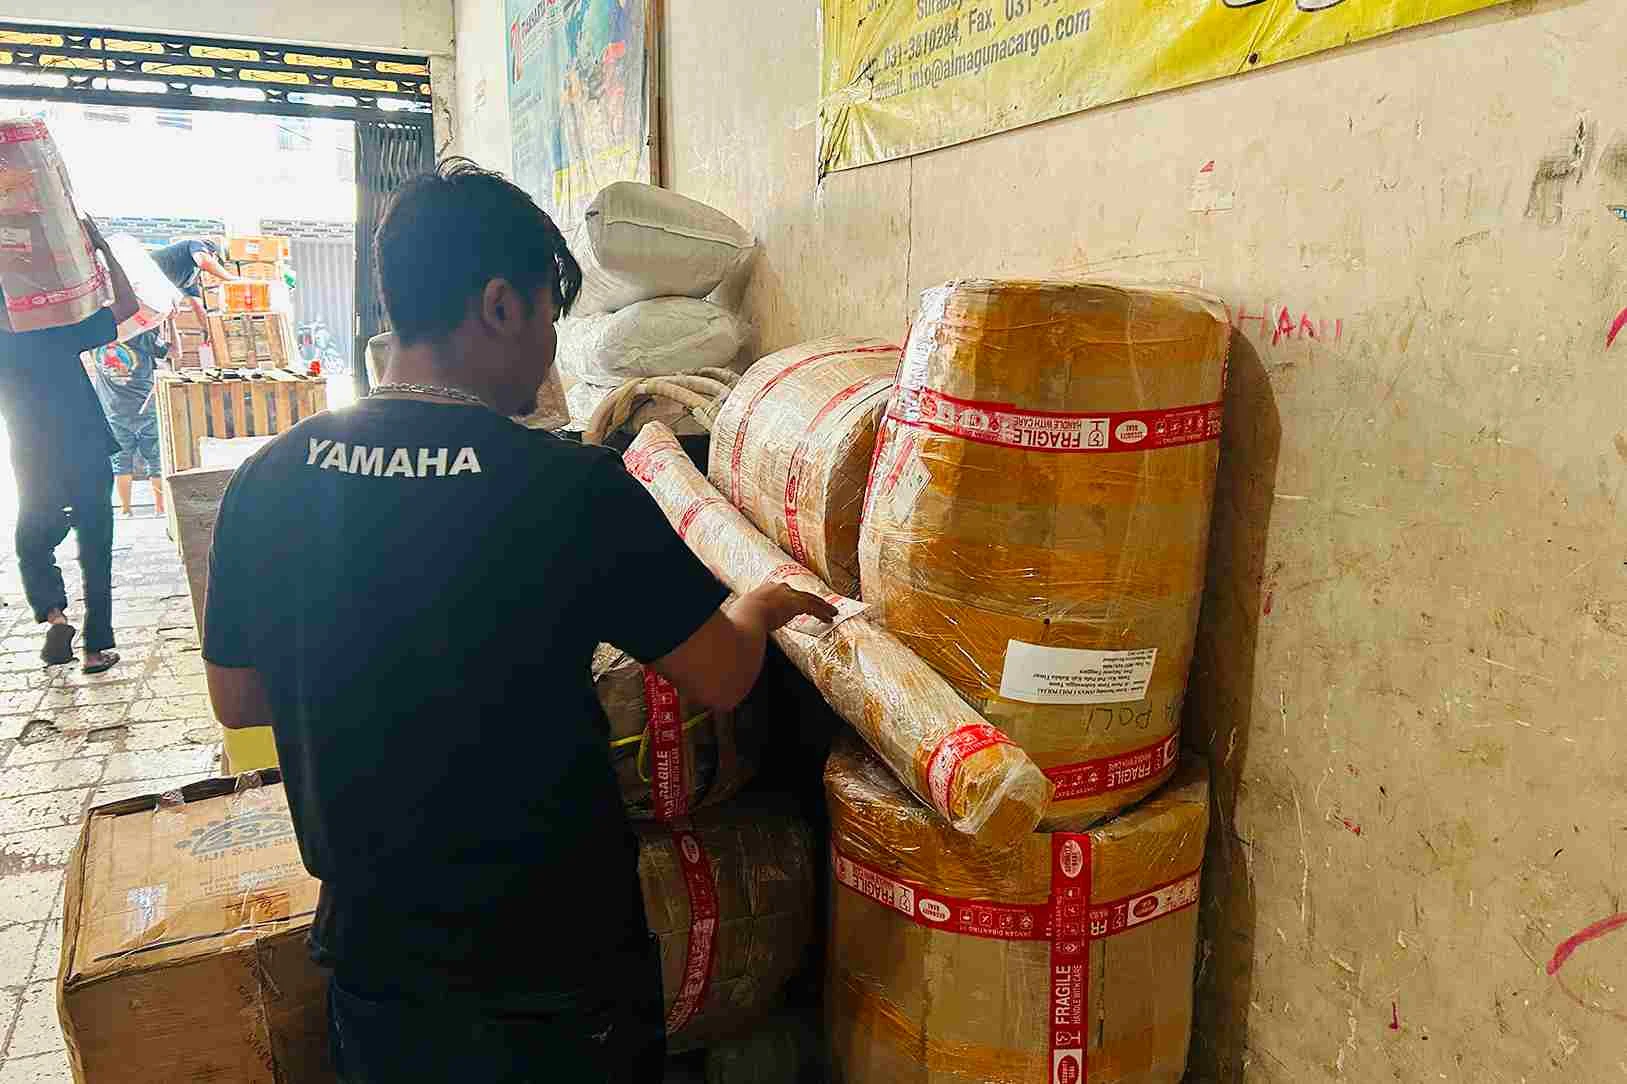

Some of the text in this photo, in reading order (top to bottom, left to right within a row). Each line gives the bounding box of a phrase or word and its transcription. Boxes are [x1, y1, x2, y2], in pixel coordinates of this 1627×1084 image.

[1013, 429, 1081, 448] FRAGILE
[306, 436, 482, 478] YAMAHA
[1106, 761, 1151, 788] FRAGILE
[853, 874, 895, 906] FRAGILE
[1055, 964, 1071, 1025] FRAGILE
